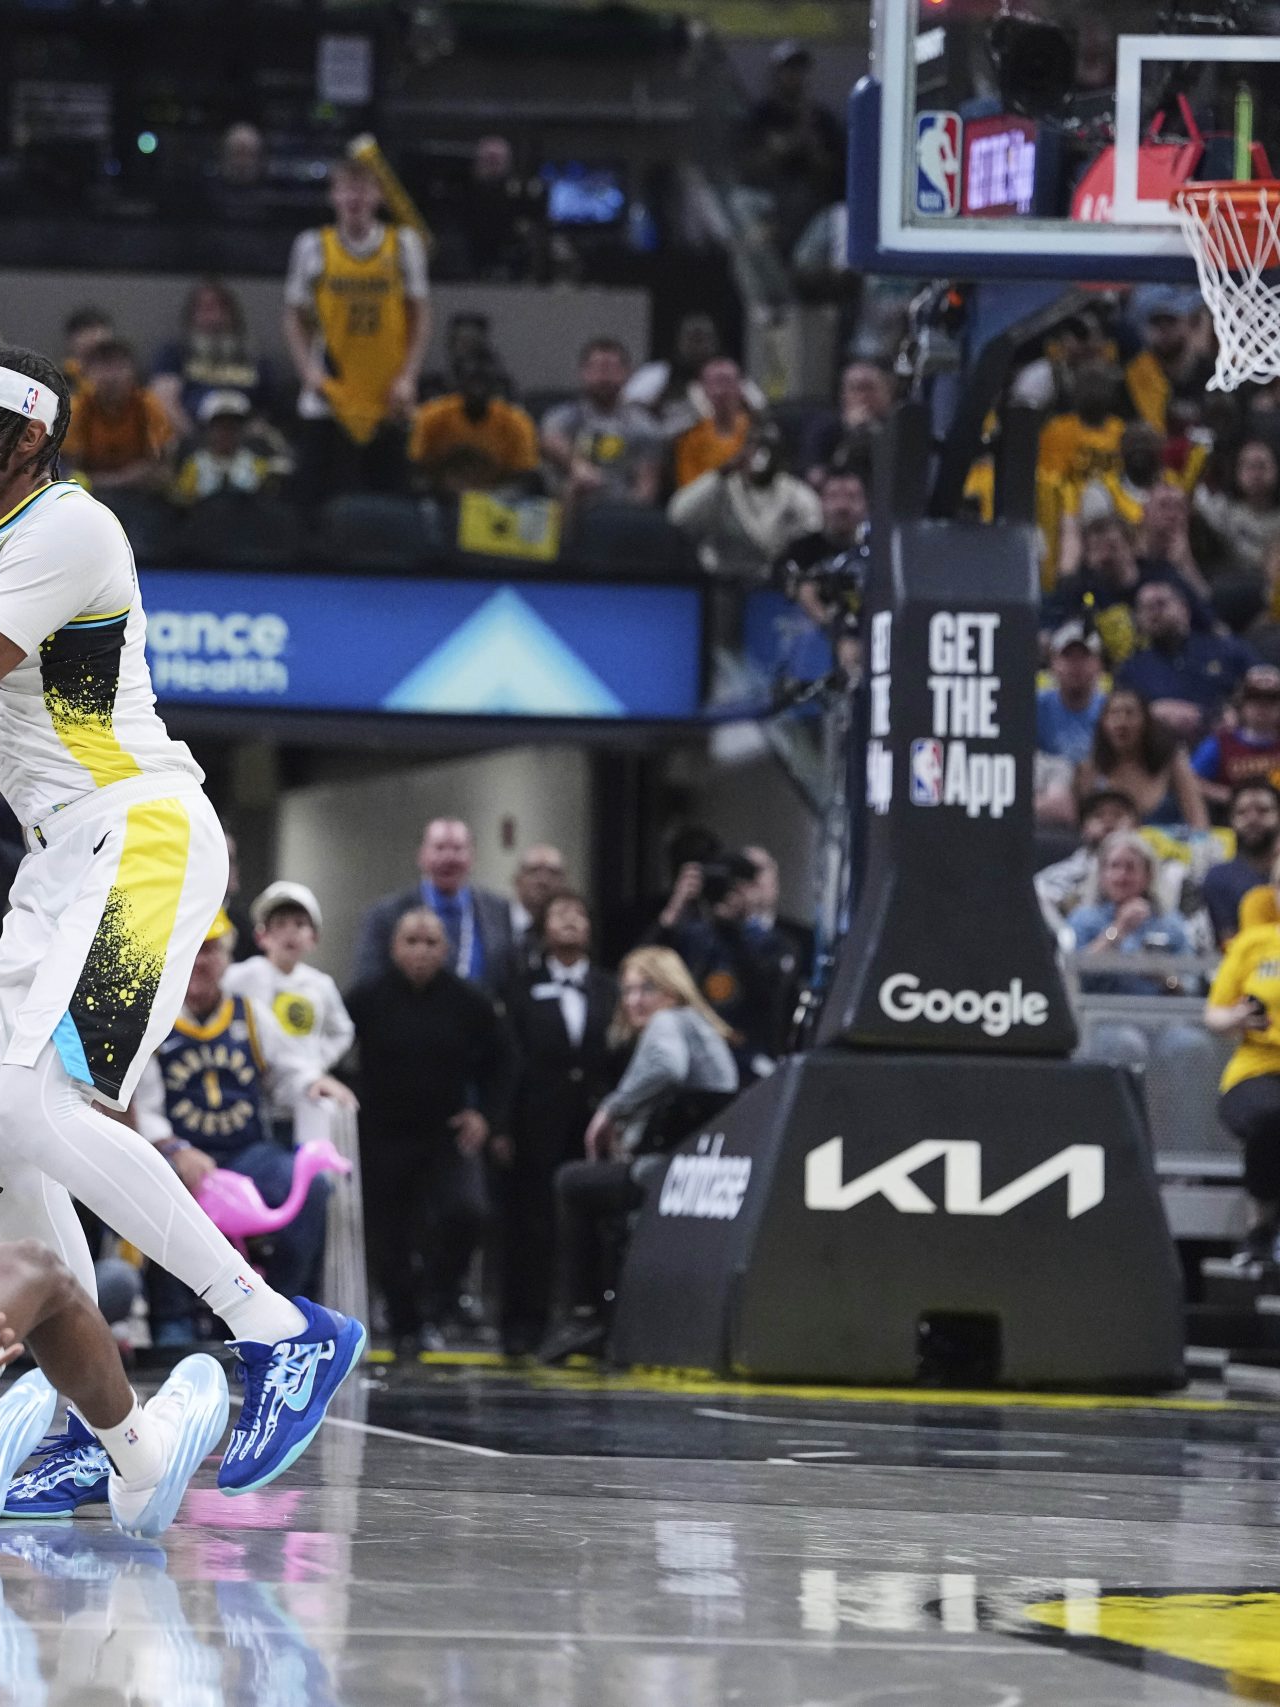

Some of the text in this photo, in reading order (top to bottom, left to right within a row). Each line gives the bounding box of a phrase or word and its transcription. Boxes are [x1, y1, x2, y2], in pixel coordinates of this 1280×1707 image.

[928, 611, 1001, 674] GET
[927, 675, 1001, 738] THE
[943, 740, 1016, 818] App
[879, 973, 1049, 1036] Google
